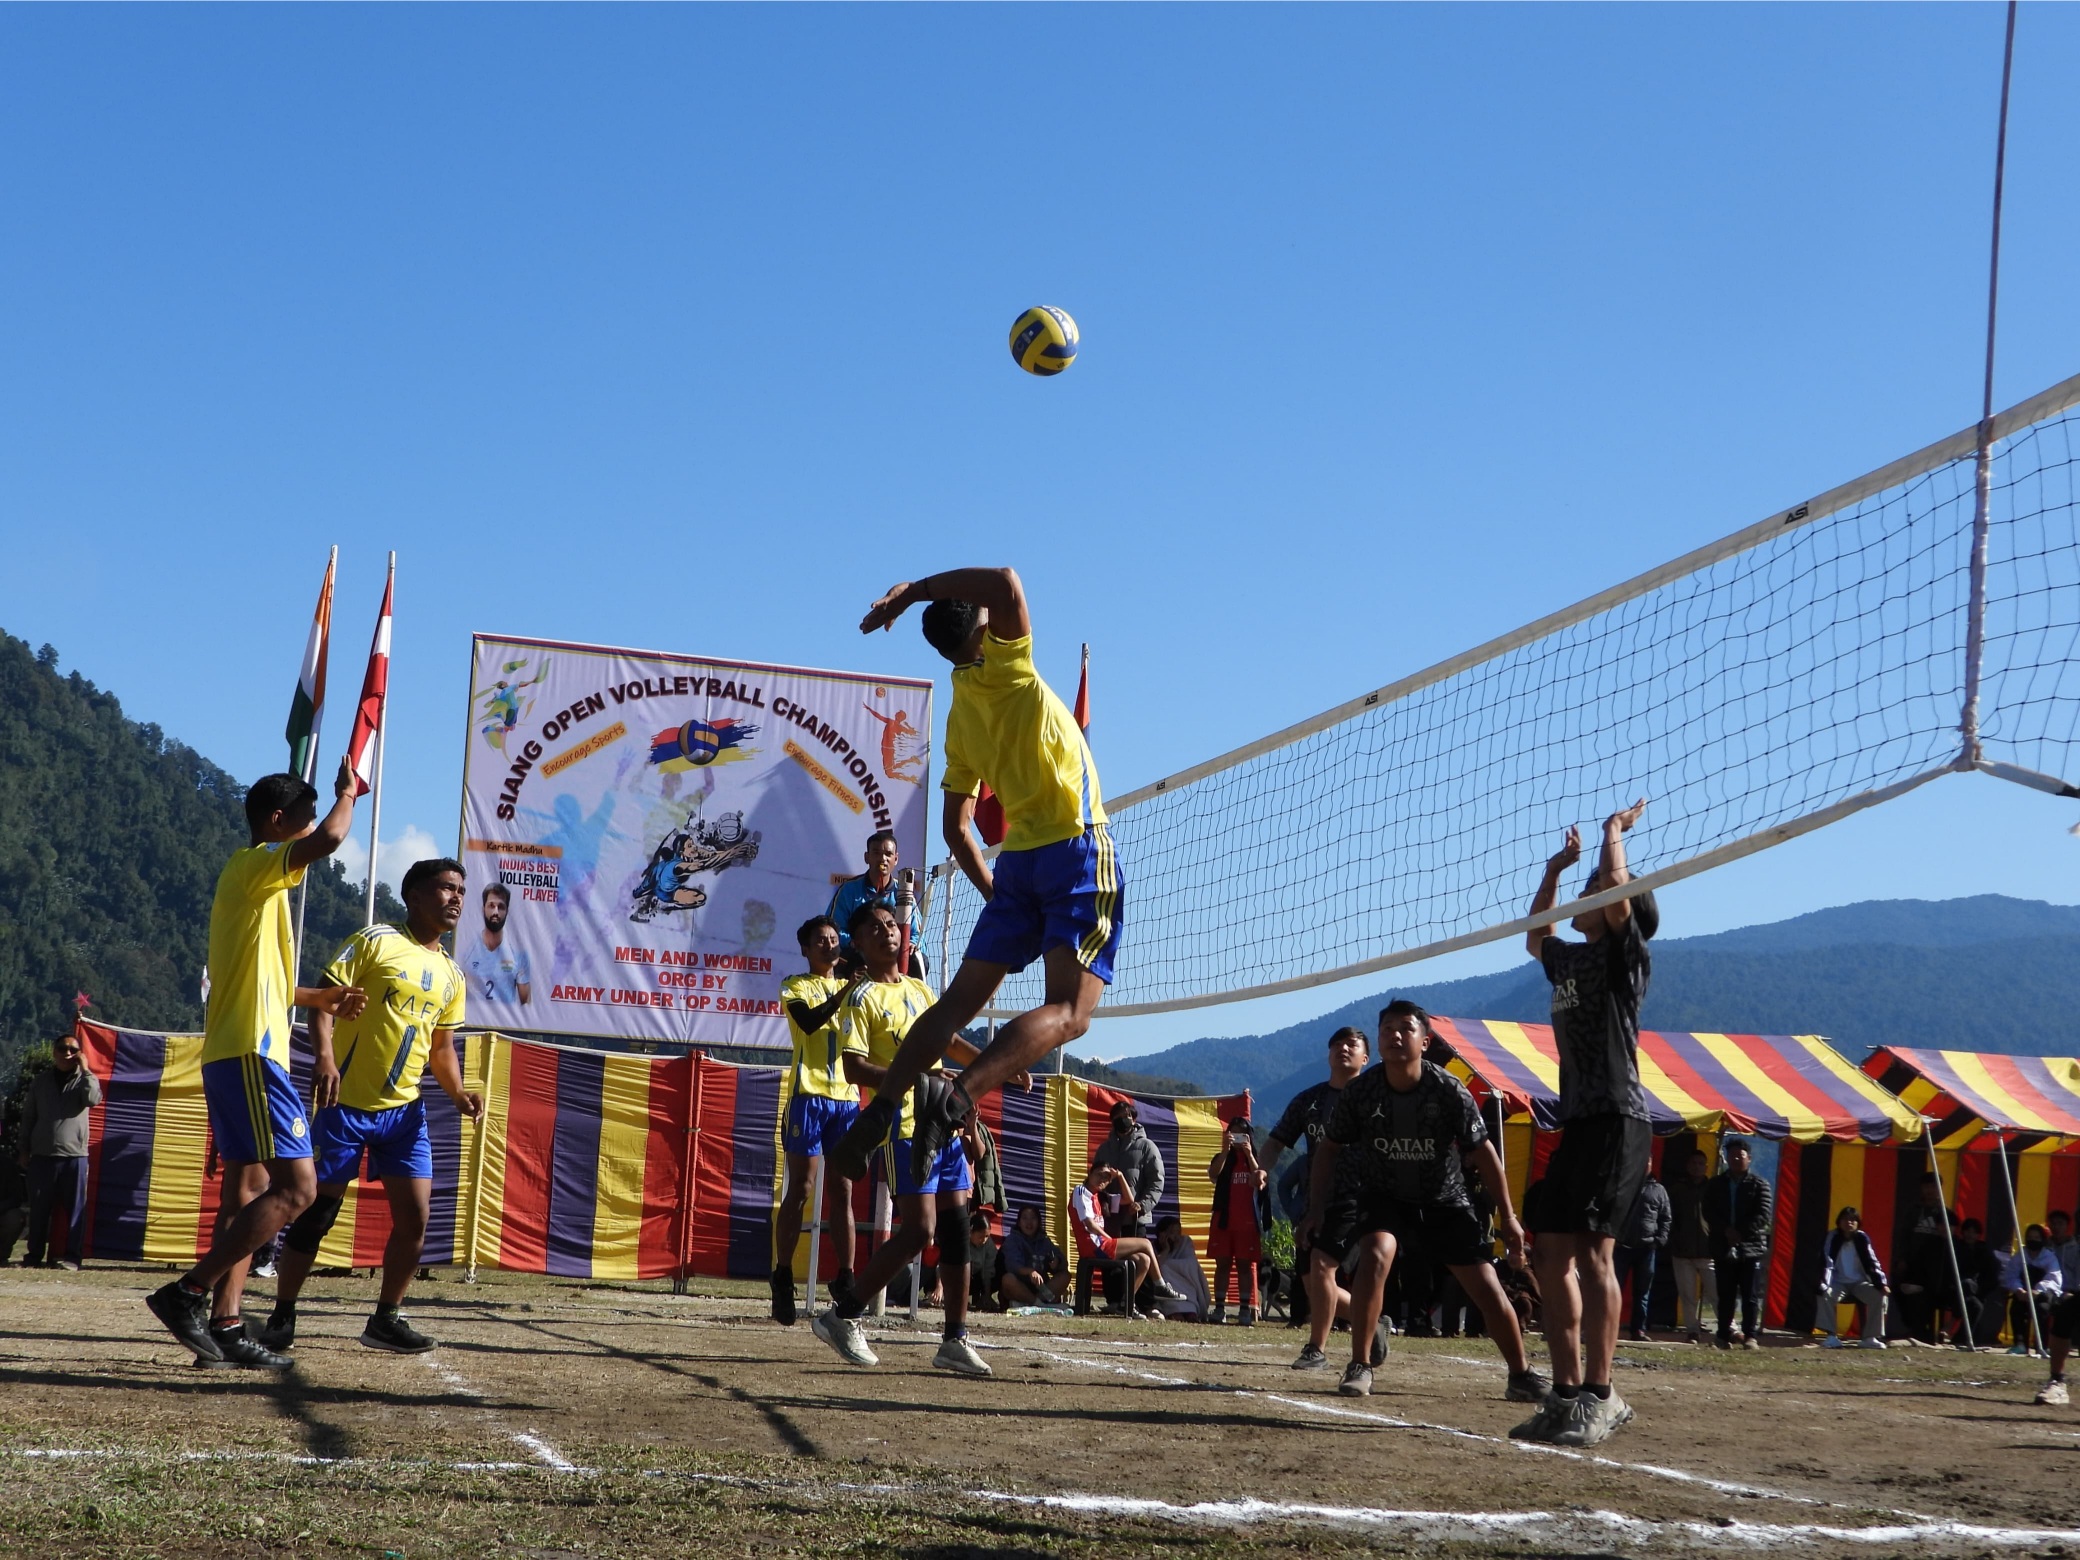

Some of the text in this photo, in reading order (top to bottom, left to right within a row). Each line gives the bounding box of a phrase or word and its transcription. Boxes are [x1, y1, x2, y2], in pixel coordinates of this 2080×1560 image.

[497, 677, 894, 835] SIANG OPEN VOLLEYBALL CHAMPIONSHI
[542, 724, 625, 776] Encourage Sports
[786, 742, 859, 810] Encourage Fitness
[486, 842, 543, 855] Kartik Madhu
[500, 858, 535, 872] INDIA'S
[500, 871, 560, 889] VOLLEYBALL
[523, 888, 560, 903] PLAYER
[615, 946, 772, 972] MEN AND WOMEN
[485, 980, 494, 1000] 2
[658, 971, 728, 990] ORG BY
[551, 984, 605, 1001] ARMY
[610, 988, 674, 1008] UNDER
[1374, 1137, 1435, 1154] QATAR
[1388, 1151, 1436, 1161] AIRWAYS
